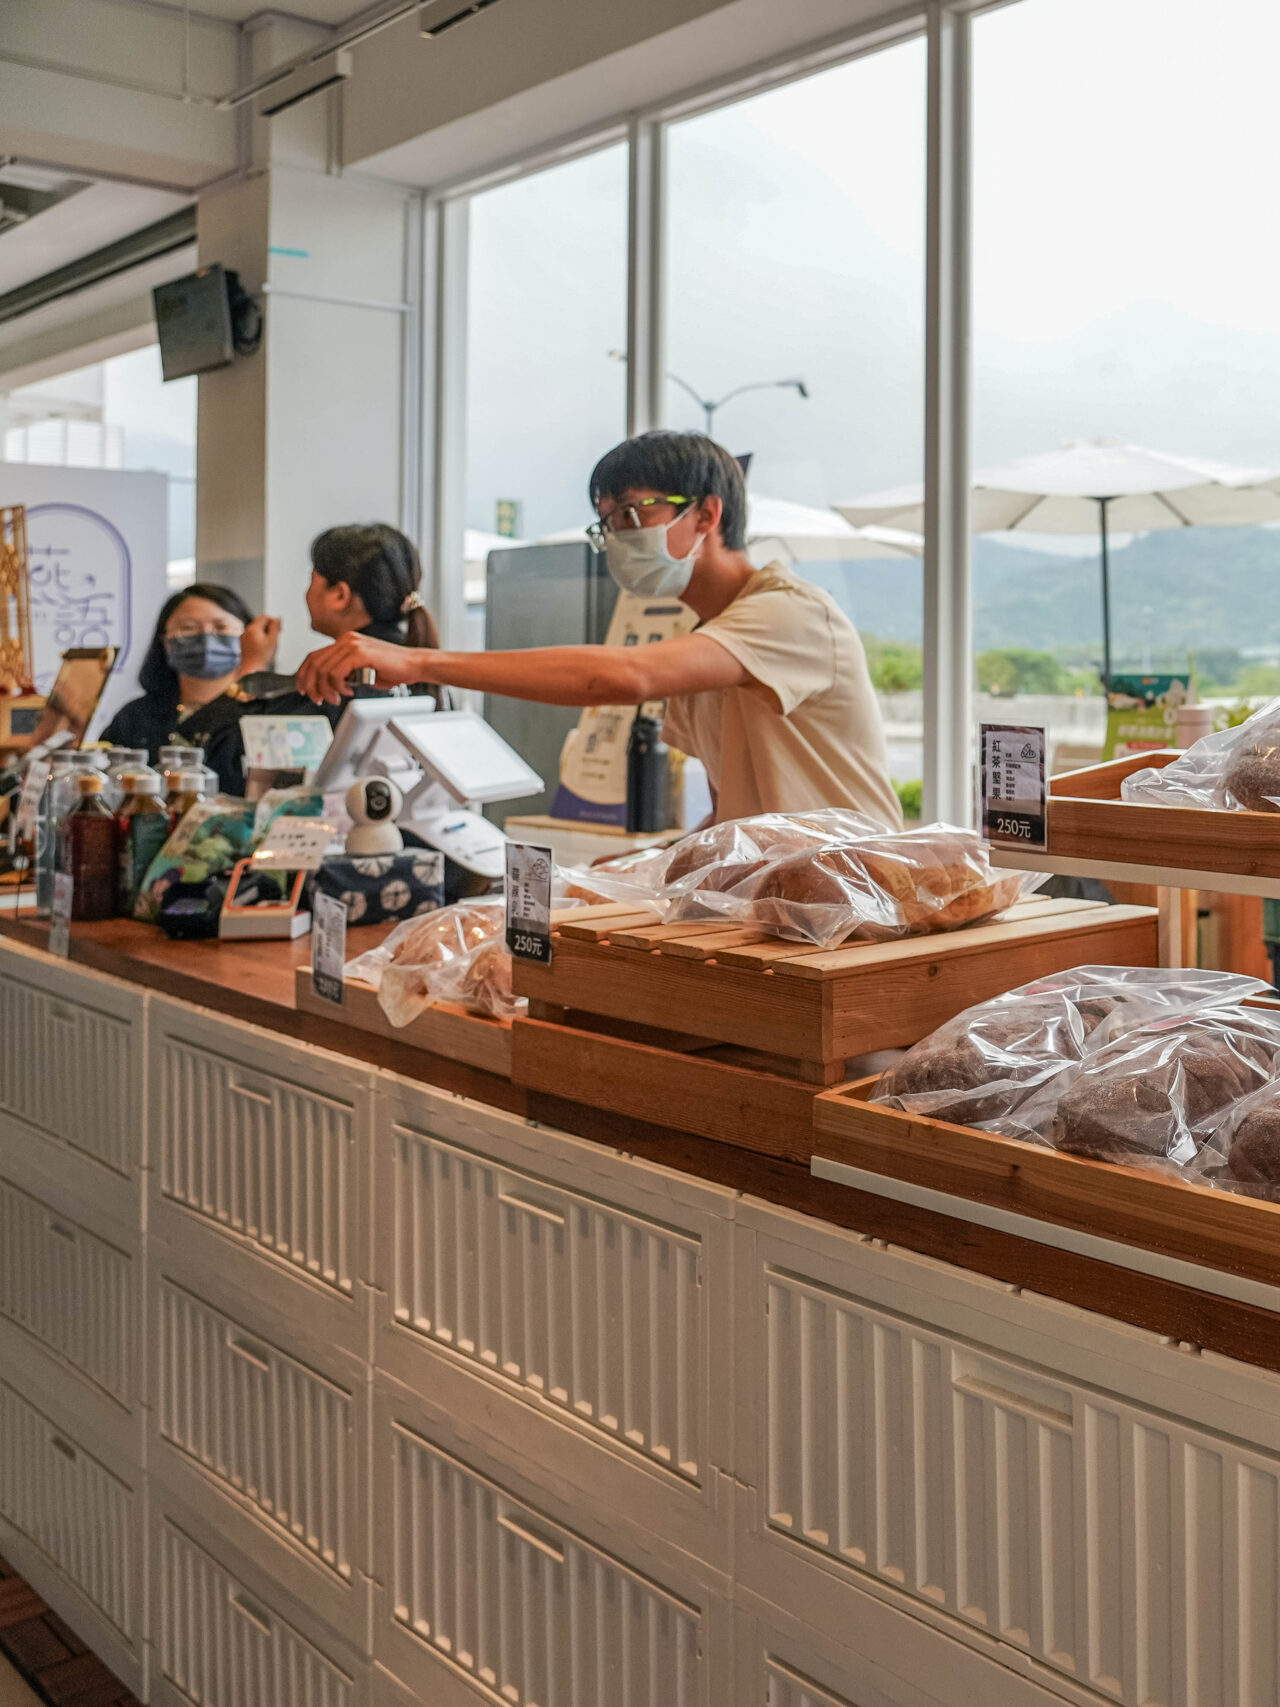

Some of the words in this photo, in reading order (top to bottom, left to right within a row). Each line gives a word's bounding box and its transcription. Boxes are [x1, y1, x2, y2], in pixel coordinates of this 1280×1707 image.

[991, 739, 1002, 800] 紅茶堅果
[997, 818, 1032, 838] 250元
[514, 934, 543, 956] 250元
